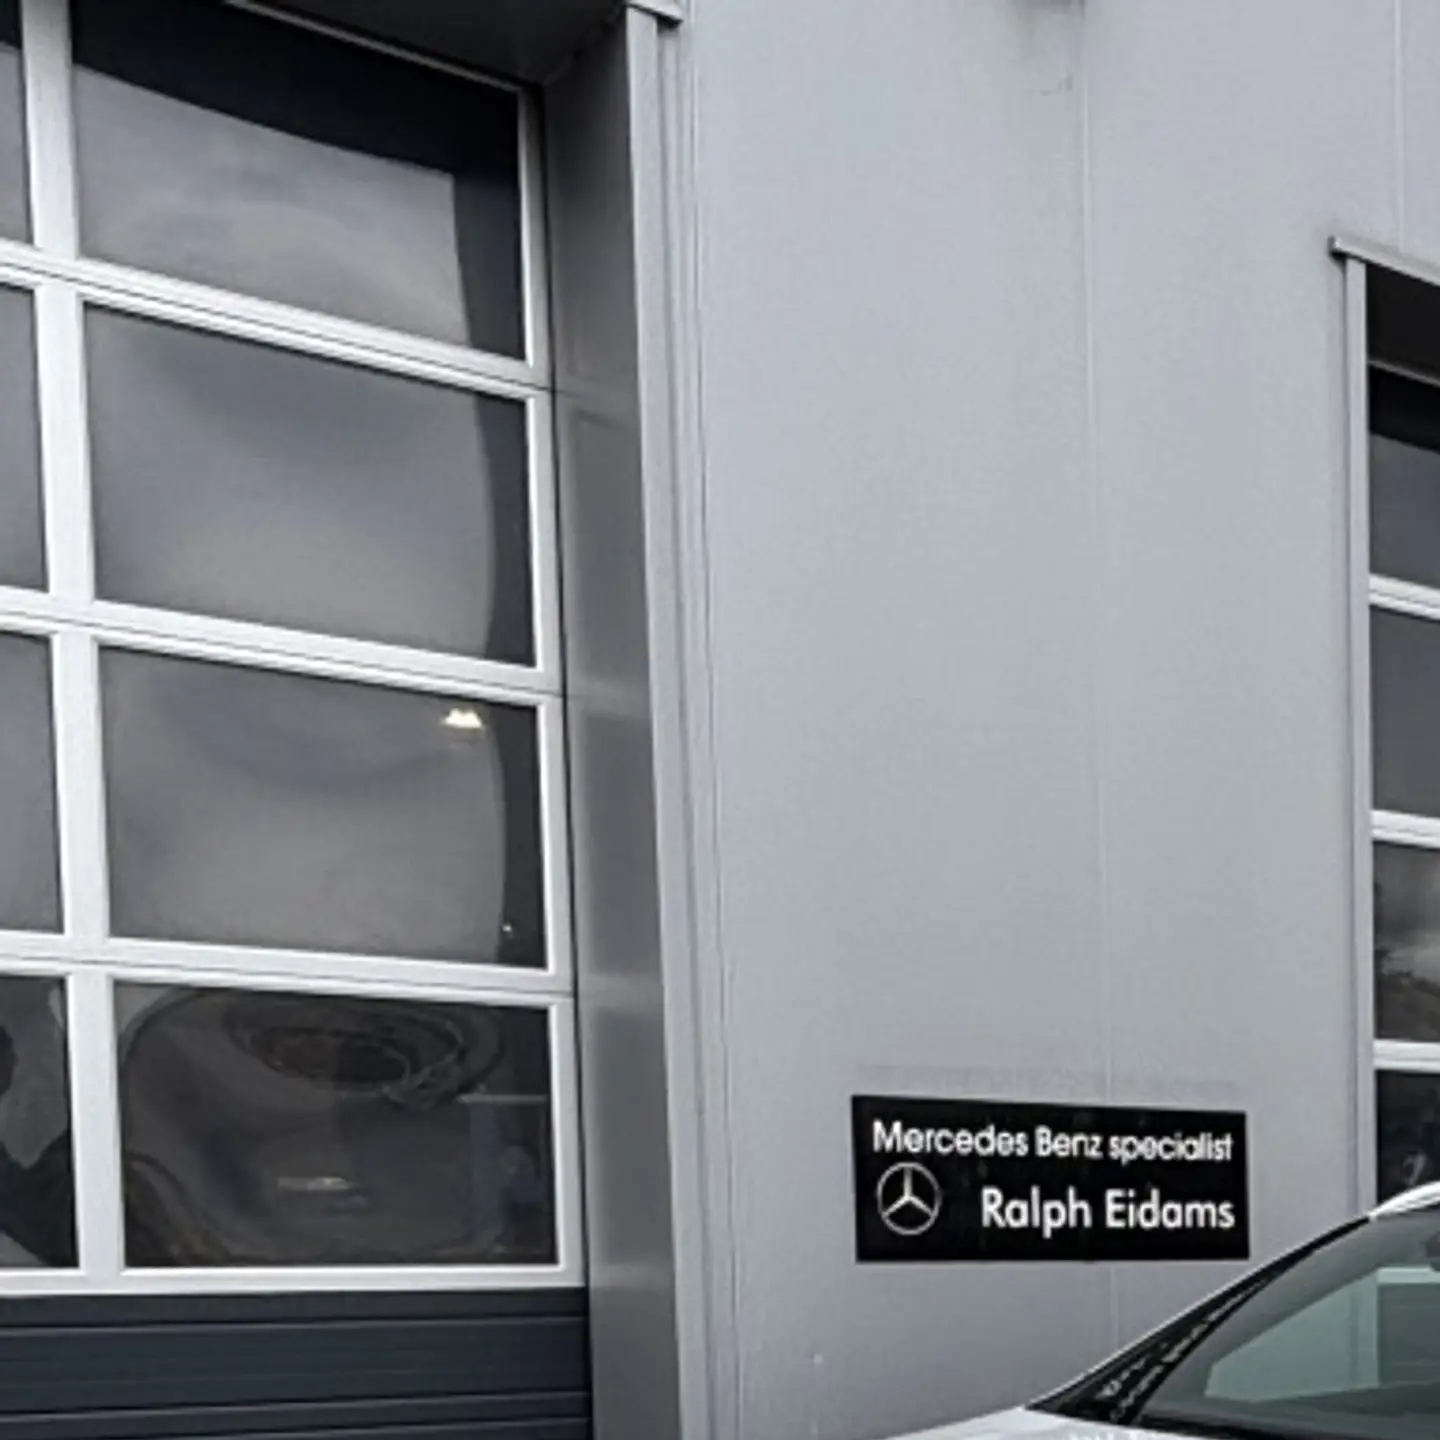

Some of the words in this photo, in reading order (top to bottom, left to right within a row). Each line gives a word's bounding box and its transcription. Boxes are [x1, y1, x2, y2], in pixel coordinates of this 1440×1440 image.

[872, 1117, 1029, 1157] Mercedes
[1034, 1125, 1103, 1159] Benz
[1108, 1132, 1234, 1166] specialist
[981, 1185, 1093, 1239] Ralph
[1104, 1188, 1236, 1229] Eidams
